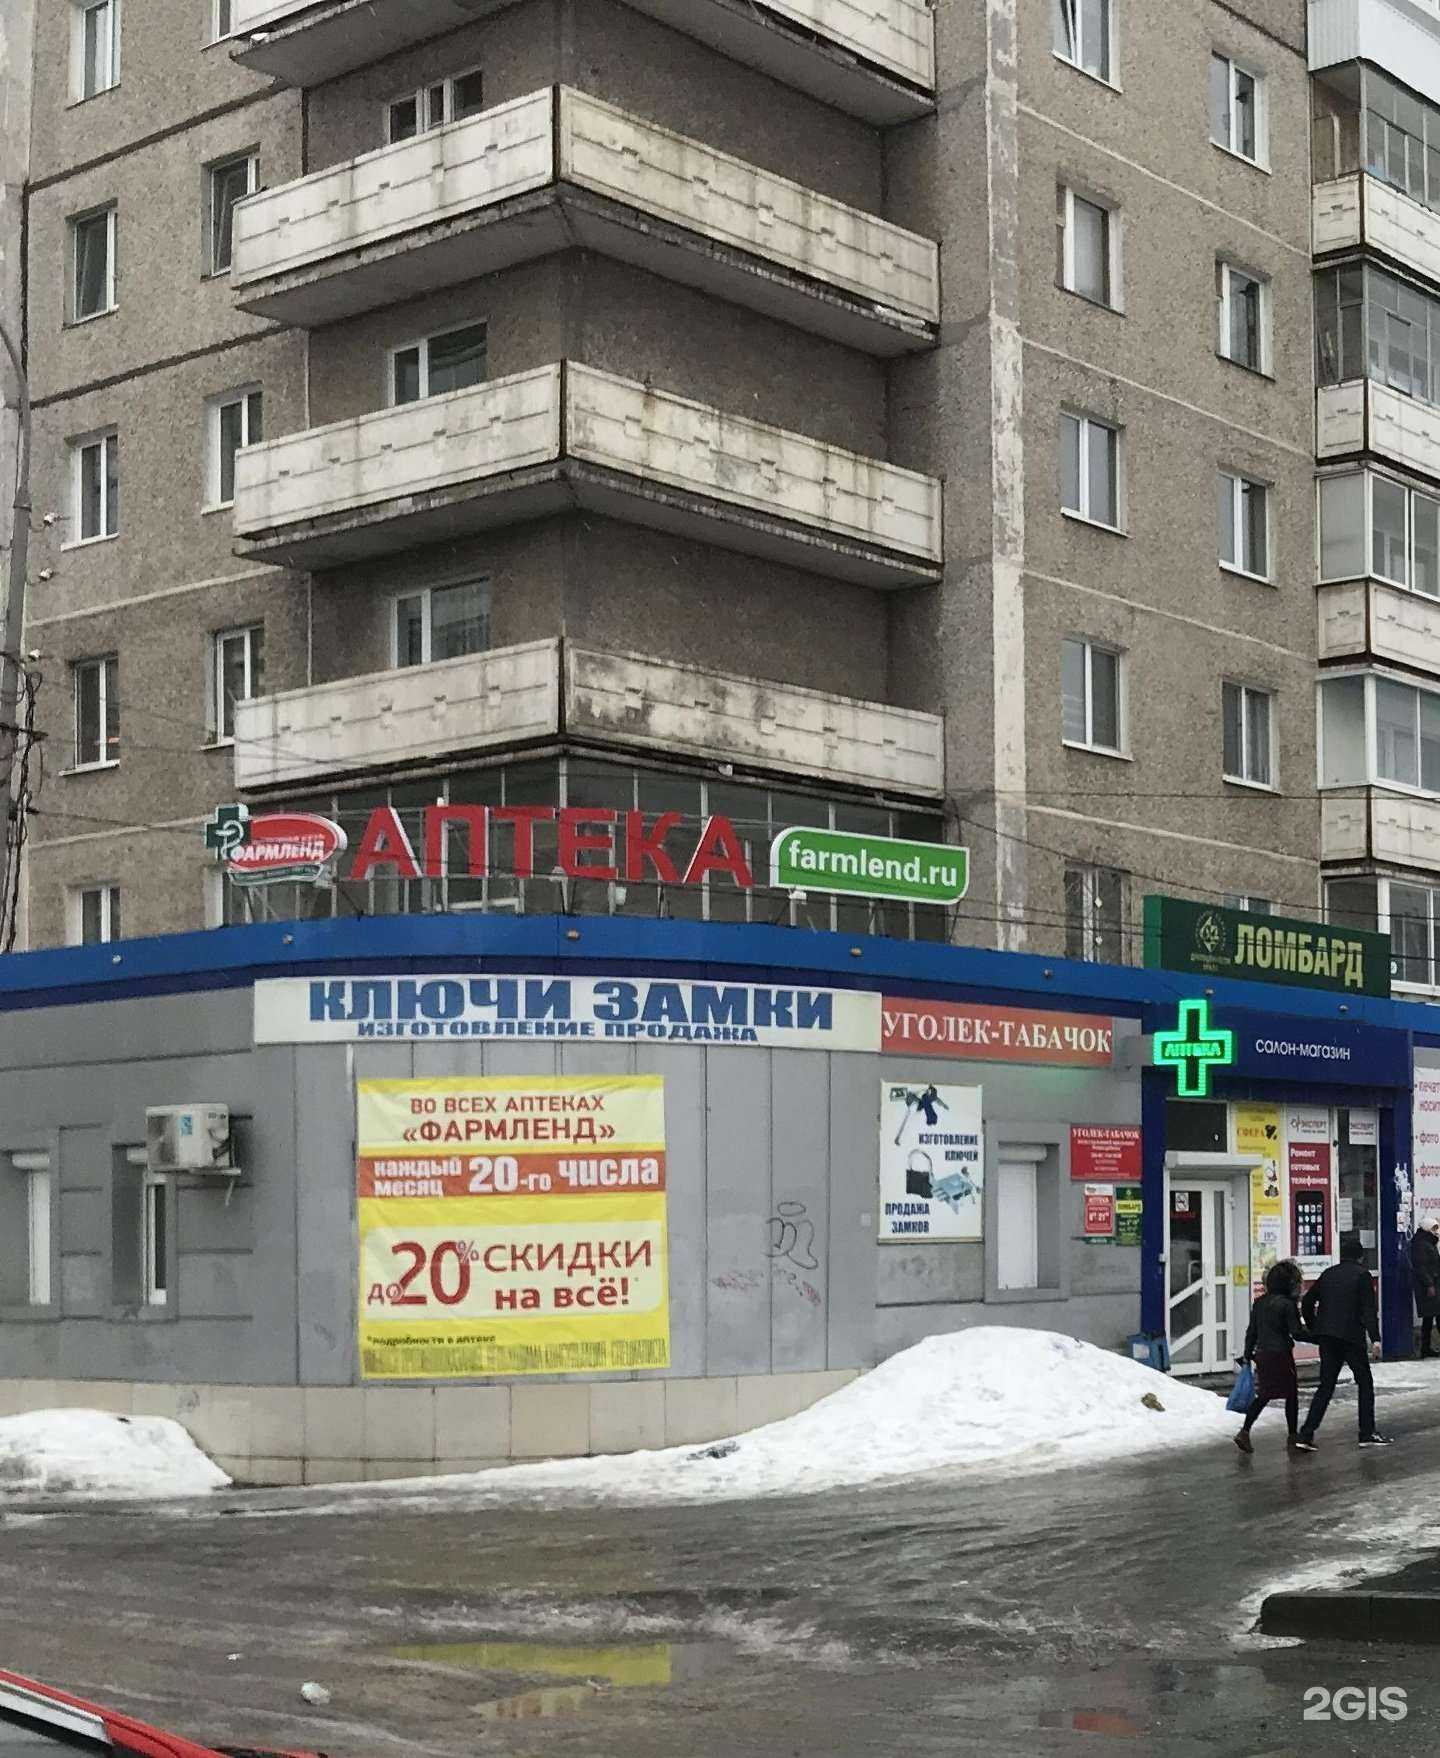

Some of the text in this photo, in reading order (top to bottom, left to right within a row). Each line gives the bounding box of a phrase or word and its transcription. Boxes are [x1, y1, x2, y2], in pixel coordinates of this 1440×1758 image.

[230, 838, 326, 862] ФАРМЛЕНД
[349, 805, 754, 888] АПТЕКА
[788, 839, 957, 887] farmlend.ru
[1234, 923, 1364, 989] ЛОМБАРД
[309, 979, 833, 1031] КЛЮЧИ ЗАМКИ
[358, 1020, 759, 1043] ИЗГОТОВЛЕНИЕ ПРОДАЖА
[882, 1010, 1112, 1054] УГОЛЕК-ТАБАЧОК
[1164, 1041, 1222, 1057] АПТЕКА
[1255, 1038, 1351, 1061] салон-магазин
[410, 1095, 605, 1114] ВО ВСЕХ АПТЕКАХ
[402, 1117, 615, 1144] «ФАРМЛЕНД»
[918, 1134, 978, 1145] ИЗГОТОВЛЕНИЕ
[374, 1157, 462, 1177] каждый
[468, 1155, 660, 1193] 20-го числа
[374, 1179, 444, 1198] месяц
[885, 1203, 930, 1216] ПРОДАЖА
[892, 1221, 930, 1233] ЗАМКОВ
[367, 1283, 401, 1304] до
[483, 1240, 652, 1277] СКИДКИ
[495, 1287, 540, 1310] на
